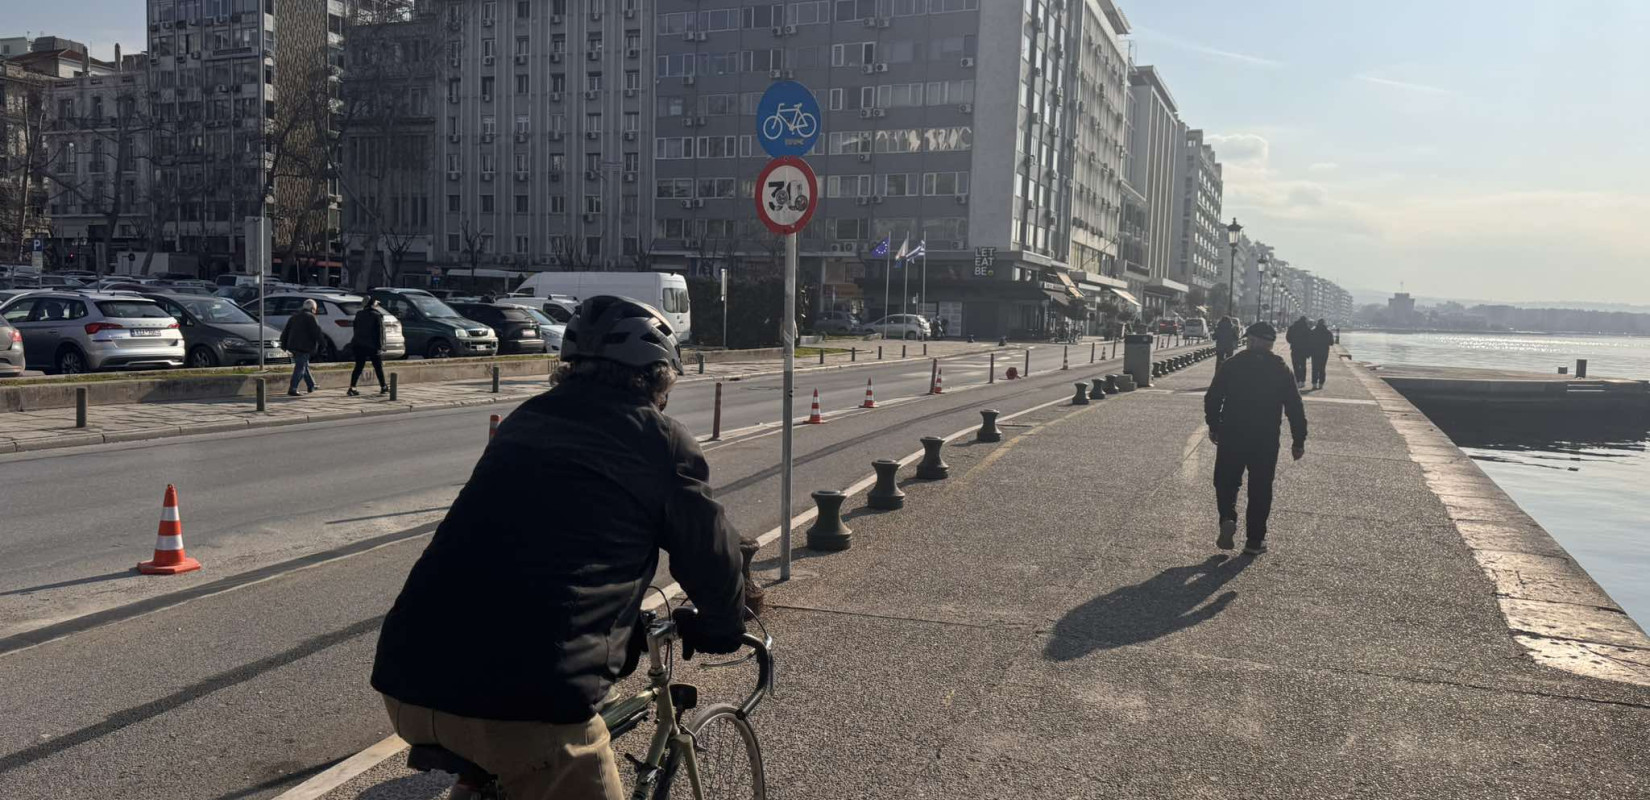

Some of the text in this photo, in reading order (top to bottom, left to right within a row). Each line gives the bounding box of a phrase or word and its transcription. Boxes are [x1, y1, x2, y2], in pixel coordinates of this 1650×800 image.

[34, 239, 41, 251] P
[975, 247, 995, 257] LET
[975, 257, 995, 266] EAT
